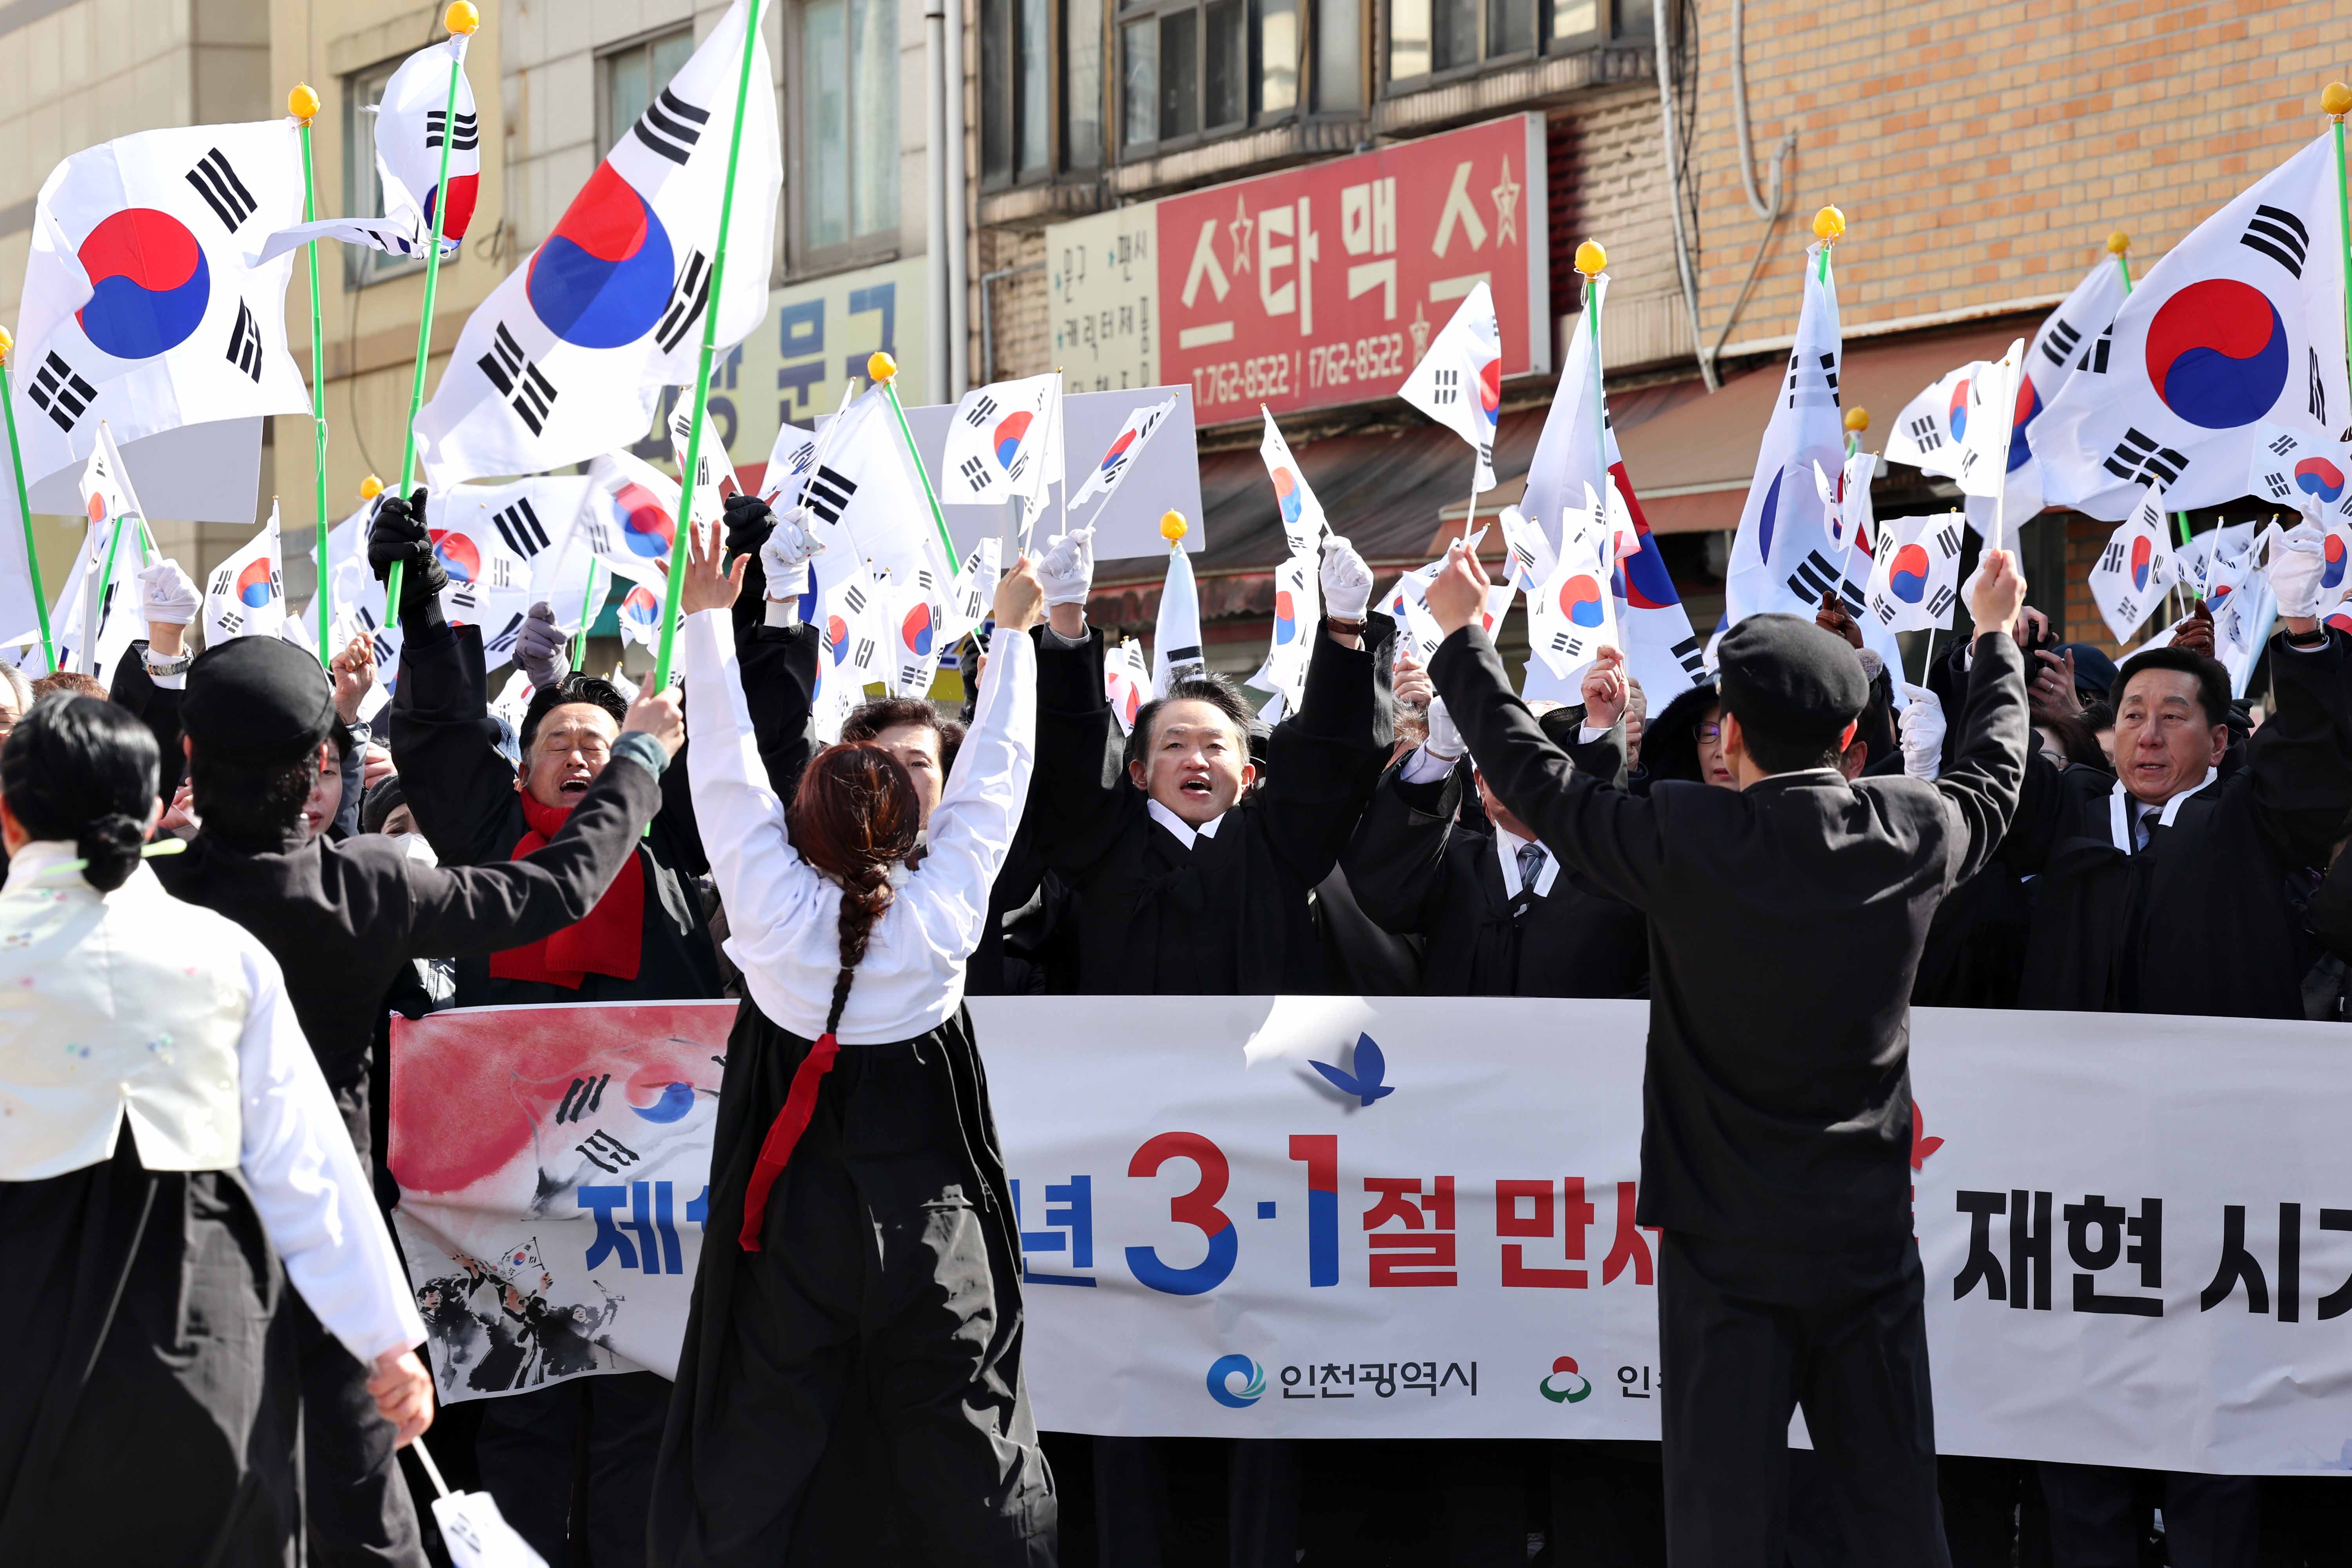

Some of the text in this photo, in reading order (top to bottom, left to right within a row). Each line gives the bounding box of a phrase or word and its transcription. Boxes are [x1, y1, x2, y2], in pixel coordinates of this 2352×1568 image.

[1065, 230, 1147, 303] 문구 팬시
[1954, 1189, 2163, 1318] 재현
[1280, 1361, 1477, 1399] 인천광역시
[1617, 1366, 1662, 1399] 인
